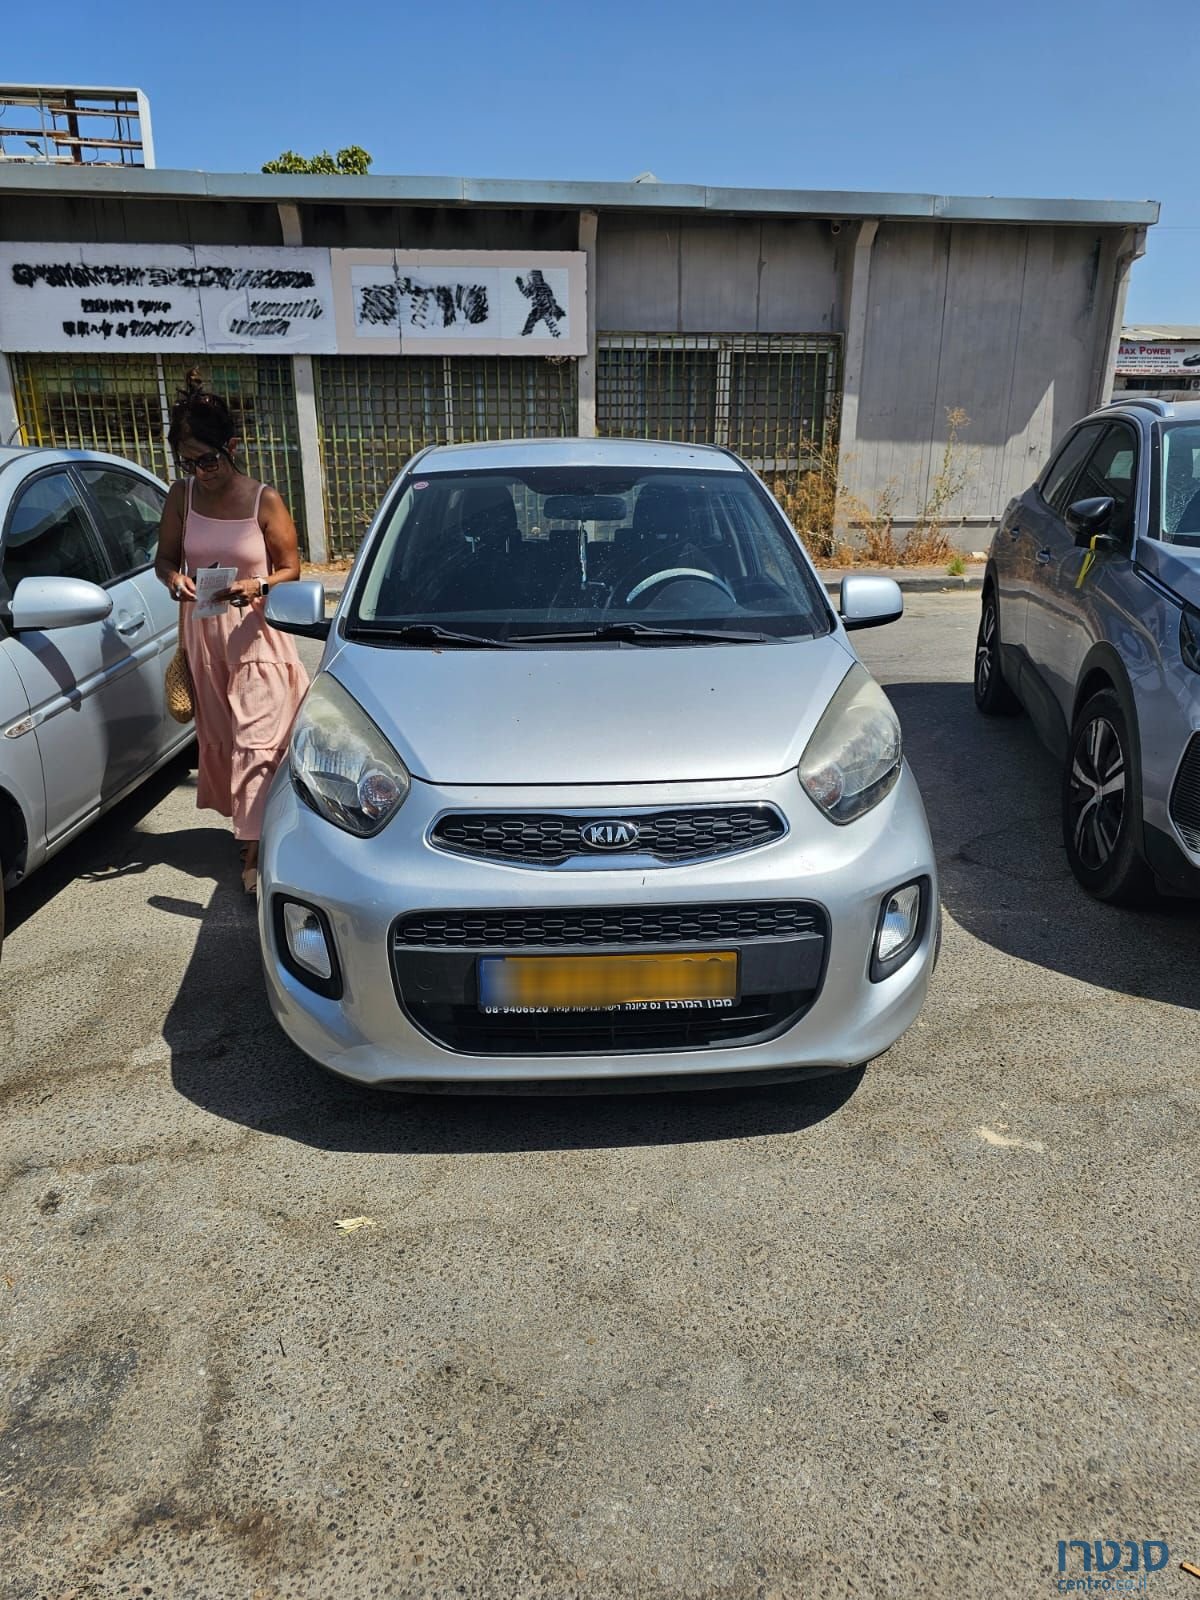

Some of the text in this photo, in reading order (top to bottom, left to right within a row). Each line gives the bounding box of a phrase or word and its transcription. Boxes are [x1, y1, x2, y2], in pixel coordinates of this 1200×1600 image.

[1139, 346, 1172, 355] POWER
[590, 826, 630, 843] KIA
[707, 998, 733, 1009] מכון
